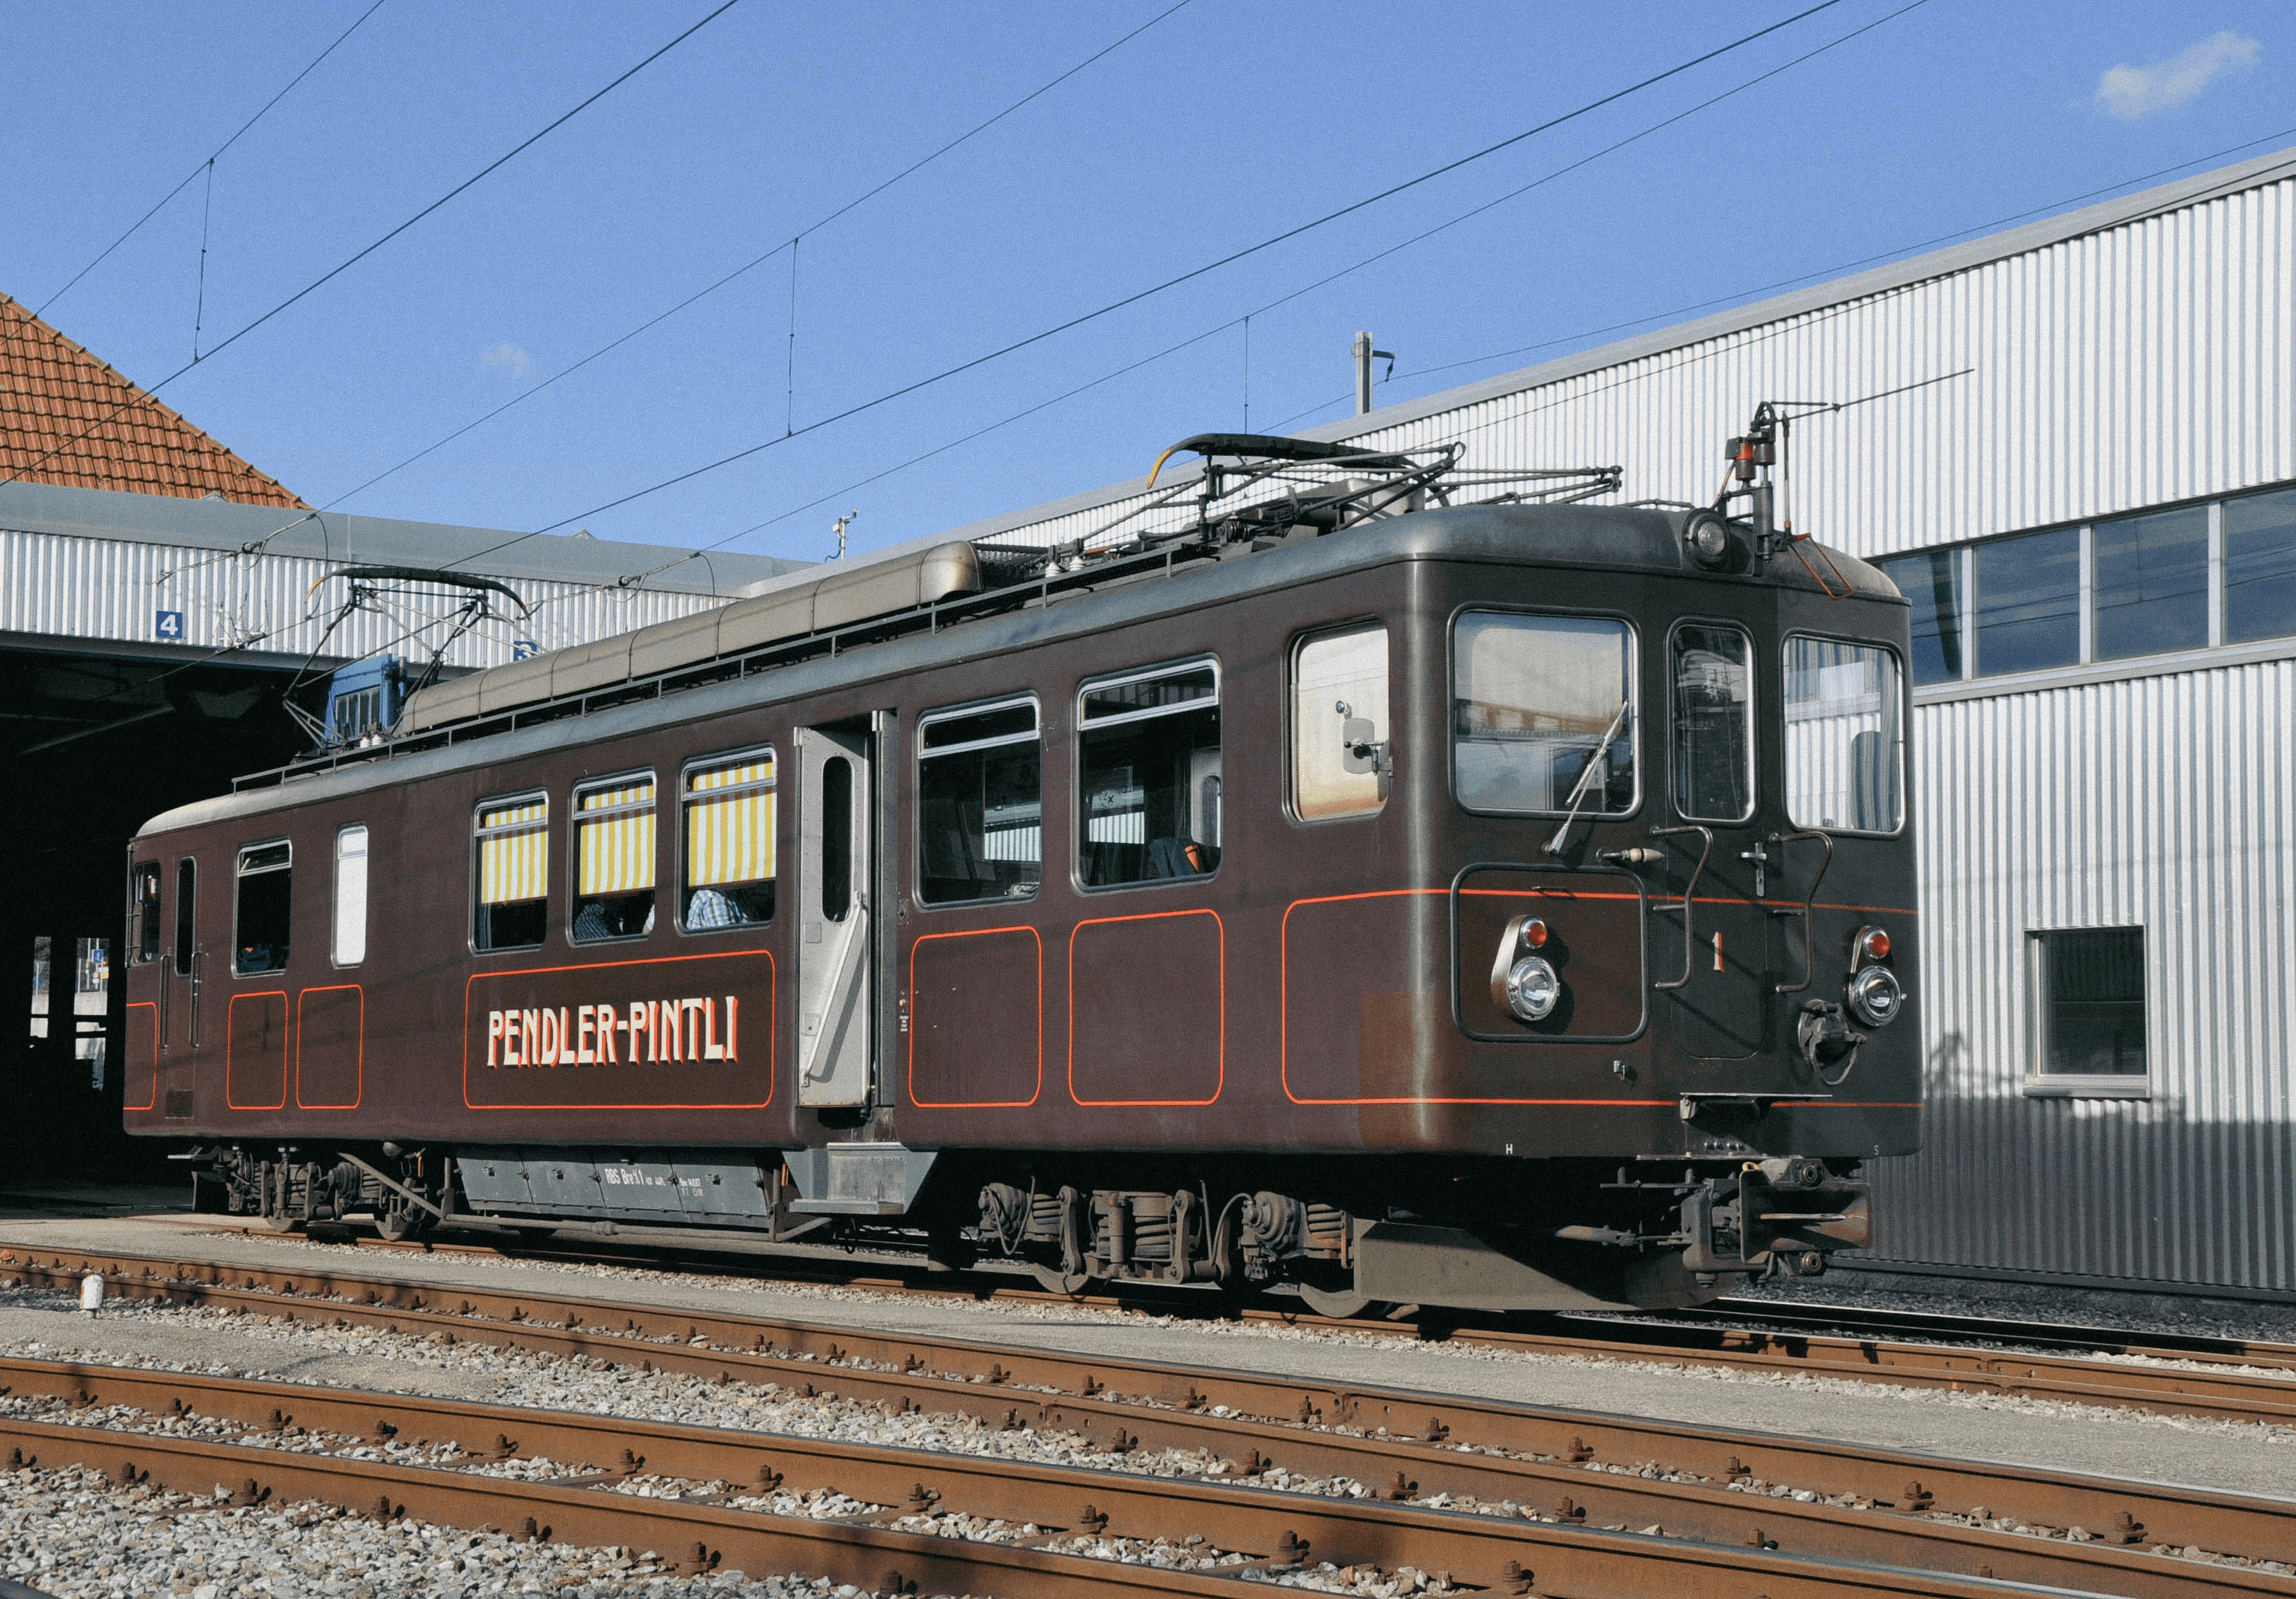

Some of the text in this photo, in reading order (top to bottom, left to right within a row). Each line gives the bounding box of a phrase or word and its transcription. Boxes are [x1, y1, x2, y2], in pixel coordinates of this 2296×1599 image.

[160, 614, 179, 636] 4
[1712, 931, 1724, 972] 1
[487, 996, 739, 1067] PENDLER-PINTLI
[1506, 1143, 1513, 1155] H
[1874, 1144, 1879, 1156] S
[605, 1168, 620, 1184] RBS
